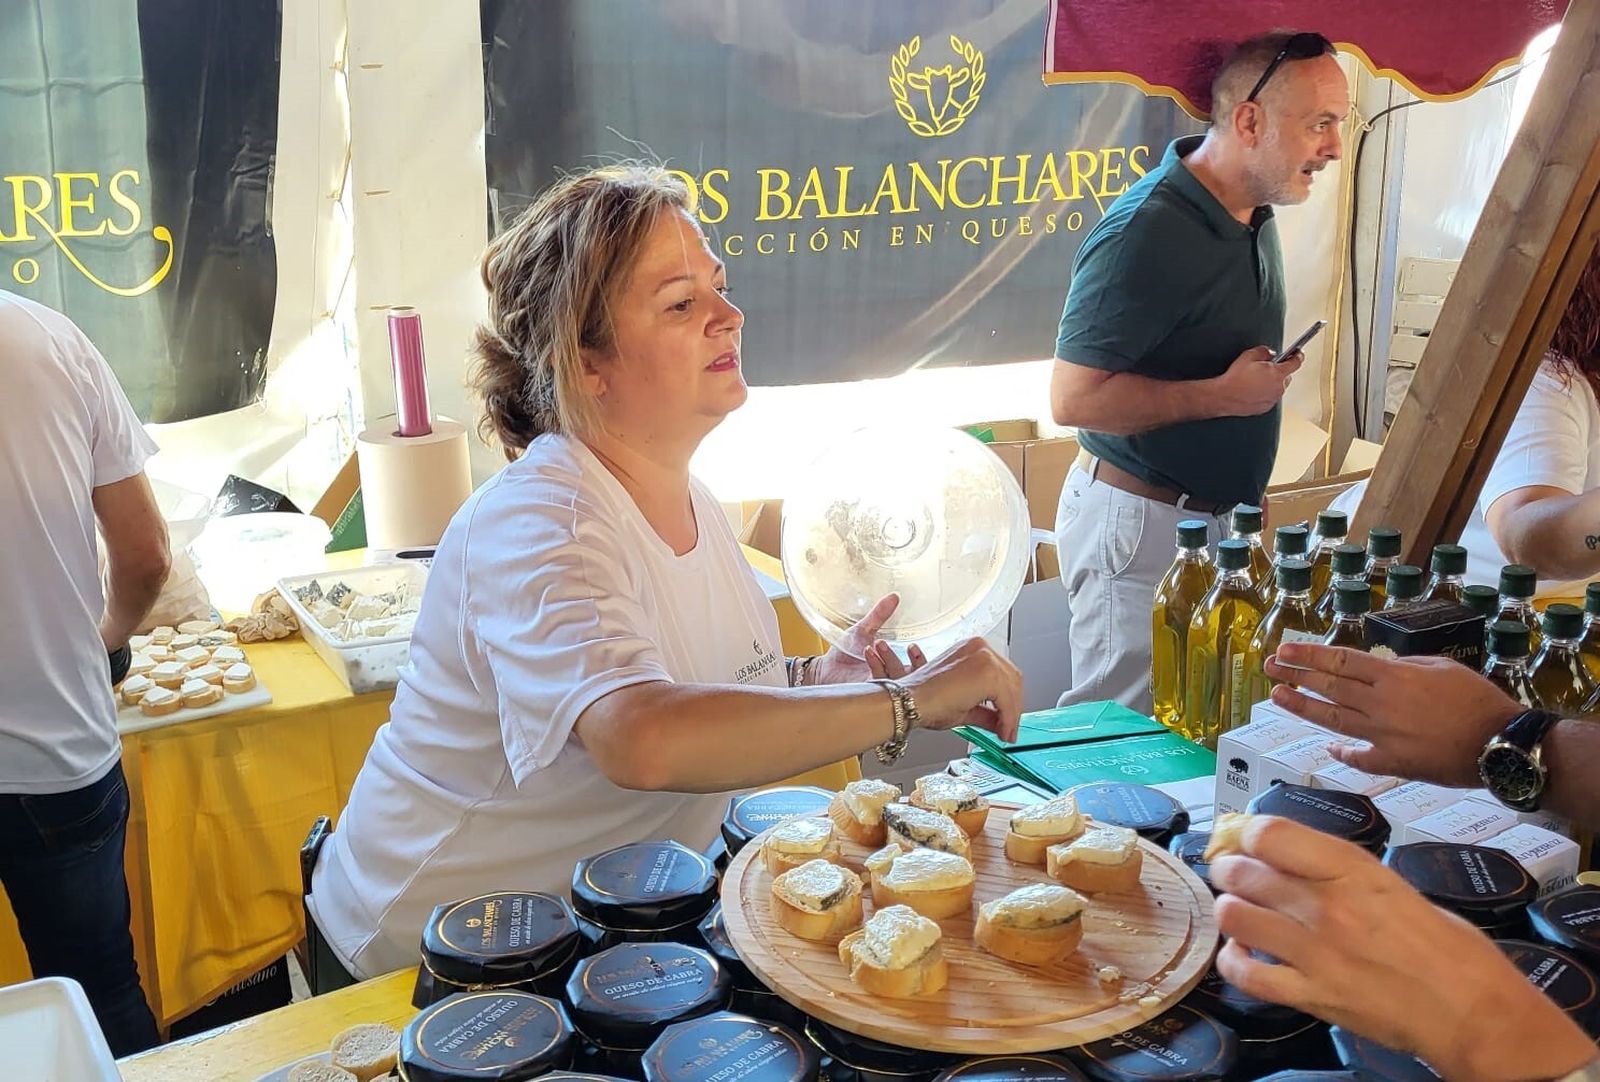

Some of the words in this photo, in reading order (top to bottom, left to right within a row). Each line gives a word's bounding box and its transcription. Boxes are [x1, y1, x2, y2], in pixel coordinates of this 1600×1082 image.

[664, 168, 730, 223] OS
[755, 145, 1150, 222] BALANCHARES
[703, 226, 861, 256] CCIÓN
[889, 223, 935, 247] EN
[960, 212, 1084, 244] QUESO
[603, 979, 644, 996] QUESO
[485, 1000, 518, 1023] QUESO
[470, 1019, 488, 1033] DE
[438, 1029, 474, 1053] CABRA
[750, 1038, 784, 1061] CABRA
[1149, 1042, 1187, 1065] CABRA
